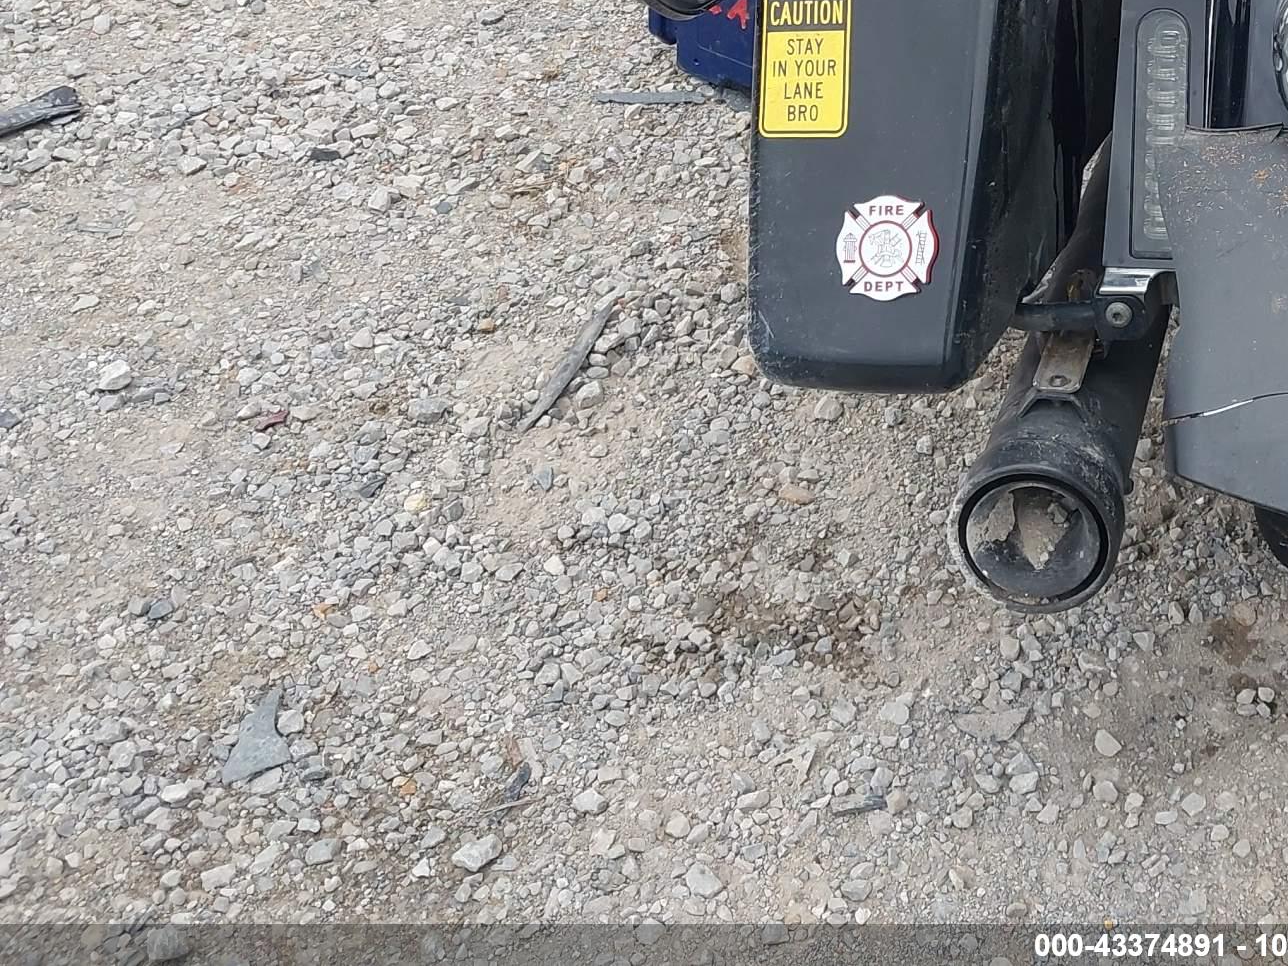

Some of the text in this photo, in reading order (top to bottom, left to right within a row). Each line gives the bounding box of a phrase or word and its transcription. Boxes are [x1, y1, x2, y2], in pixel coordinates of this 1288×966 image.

[770, 0, 844, 26] CAUTION
[786, 38, 824, 56] STAY
[772, 59, 837, 78] IN YOUR
[784, 81, 824, 100] LANE
[787, 104, 819, 122] BRO
[869, 204, 905, 217] FIRE
[863, 280, 904, 293] DEPT
